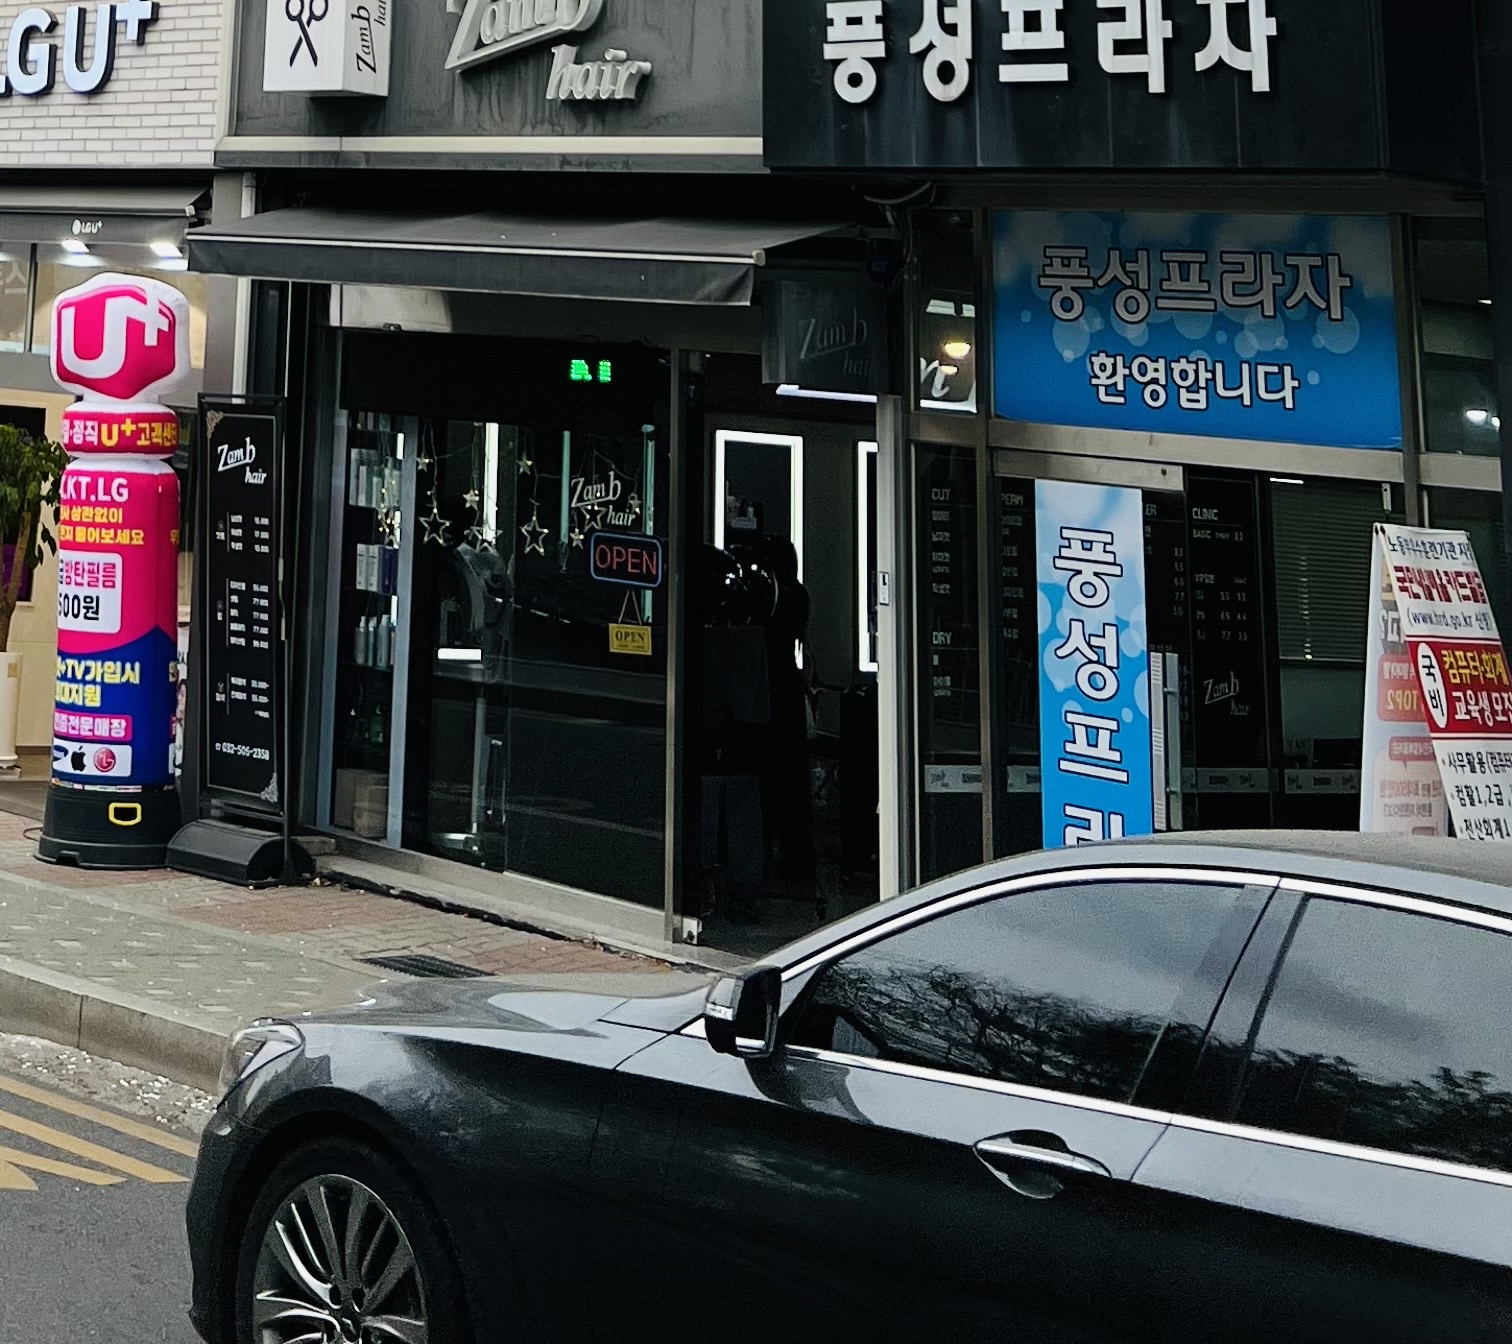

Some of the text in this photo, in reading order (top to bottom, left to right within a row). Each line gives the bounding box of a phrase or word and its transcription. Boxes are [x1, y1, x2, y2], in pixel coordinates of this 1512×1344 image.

[354, 3, 378, 75] Zamb
[546, 43, 653, 102] hair
[1038, 244, 1353, 327] 풍성프라자
[1088, 351, 1301, 412] 환영합니다
[217, 436, 256, 472] Zamb
[244, 467, 268, 485] hair
[570, 471, 622, 509] Zamb
[605, 508, 637, 528] hair
[594, 545, 658, 576] OPEN
[614, 629, 646, 645] OPEN
[1422, 652, 1445, 718] 국비
[1452, 691, 1493, 729] 교육생
